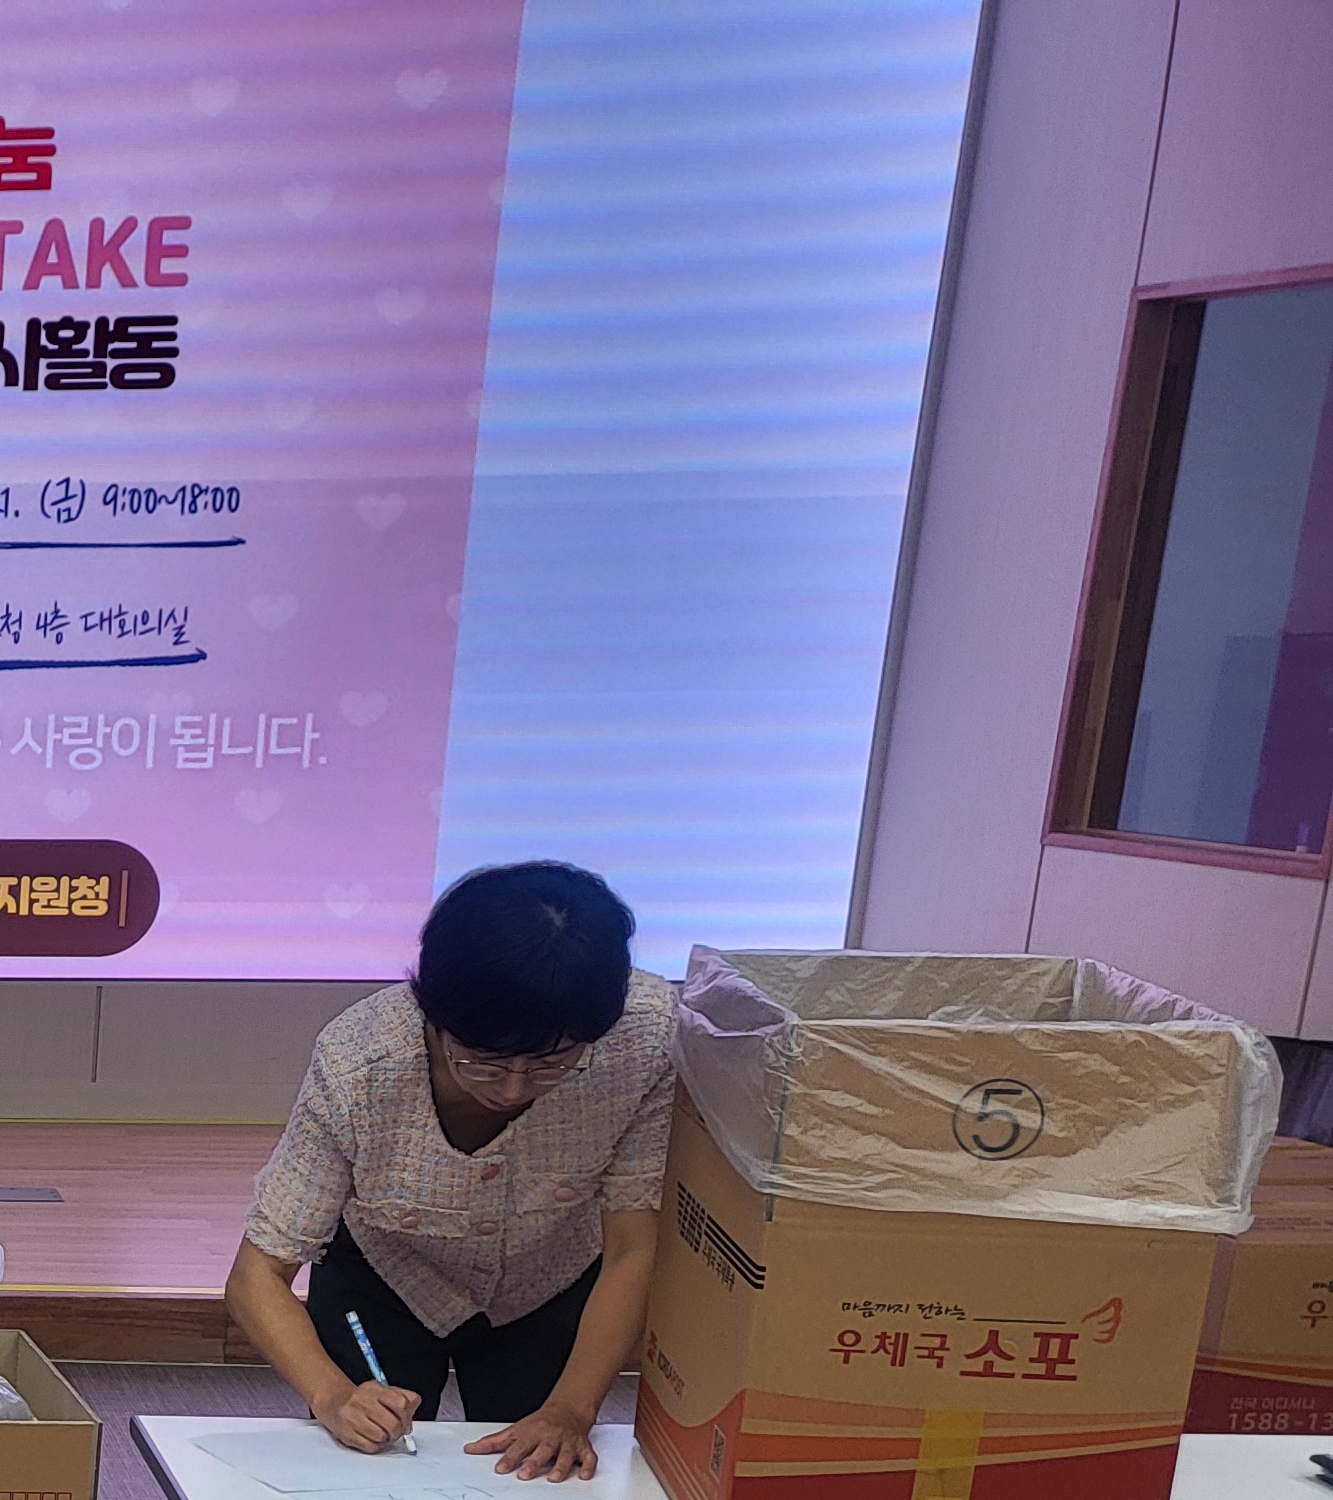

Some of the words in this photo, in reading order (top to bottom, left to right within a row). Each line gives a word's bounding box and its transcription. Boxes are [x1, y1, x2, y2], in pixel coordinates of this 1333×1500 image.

[39, 480, 86, 524] (금)
[102, 483, 241, 519] 9:00~18:00
[36, 607, 68, 640] 4층
[80, 605, 190, 646] 대회의실
[11, 712, 153, 770] 사랑이
[170, 713, 329, 769] 됩니다.
[841, 1301, 909, 1319] 마음까지
[916, 1303, 967, 1320] 전하는
[829, 1329, 950, 1368] 우체국
[959, 1330, 1079, 1381] 소포
